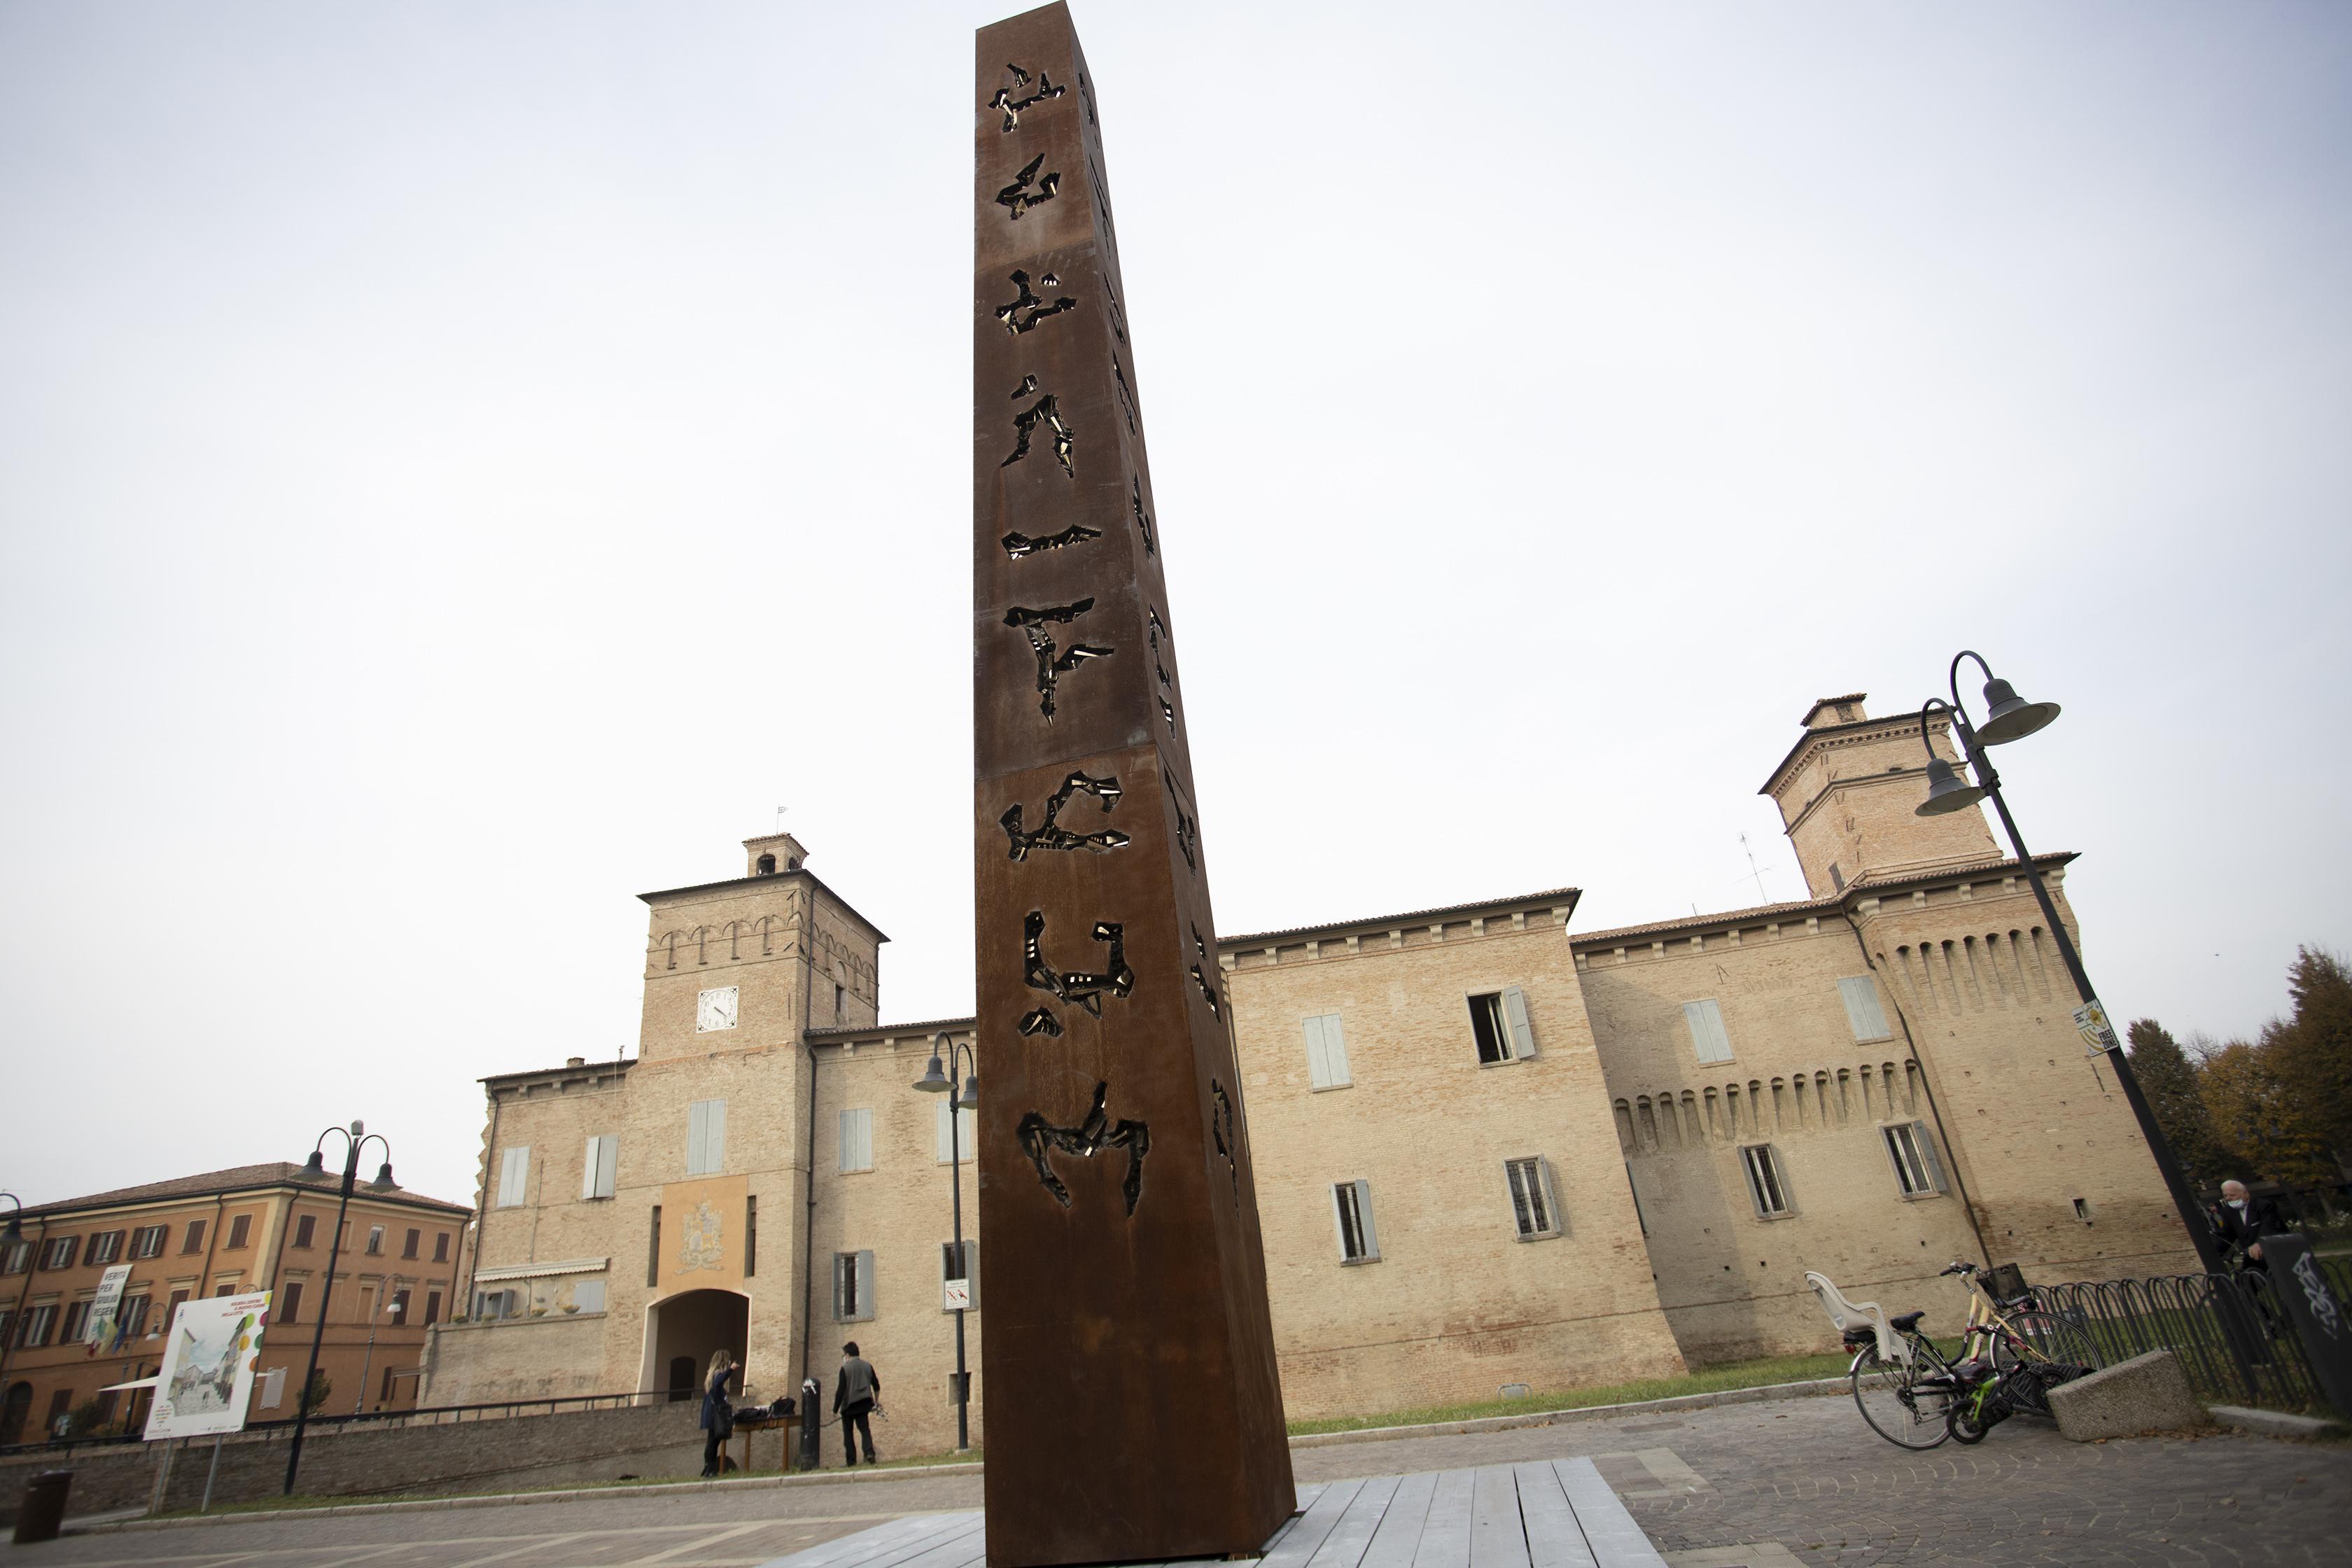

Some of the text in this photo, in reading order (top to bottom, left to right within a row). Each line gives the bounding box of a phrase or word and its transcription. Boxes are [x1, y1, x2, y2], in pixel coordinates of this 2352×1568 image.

[2098, 1029, 2113, 1041] FREE
[2101, 1037, 2117, 1049] ZONE
[99, 1284, 113, 1292] PER
